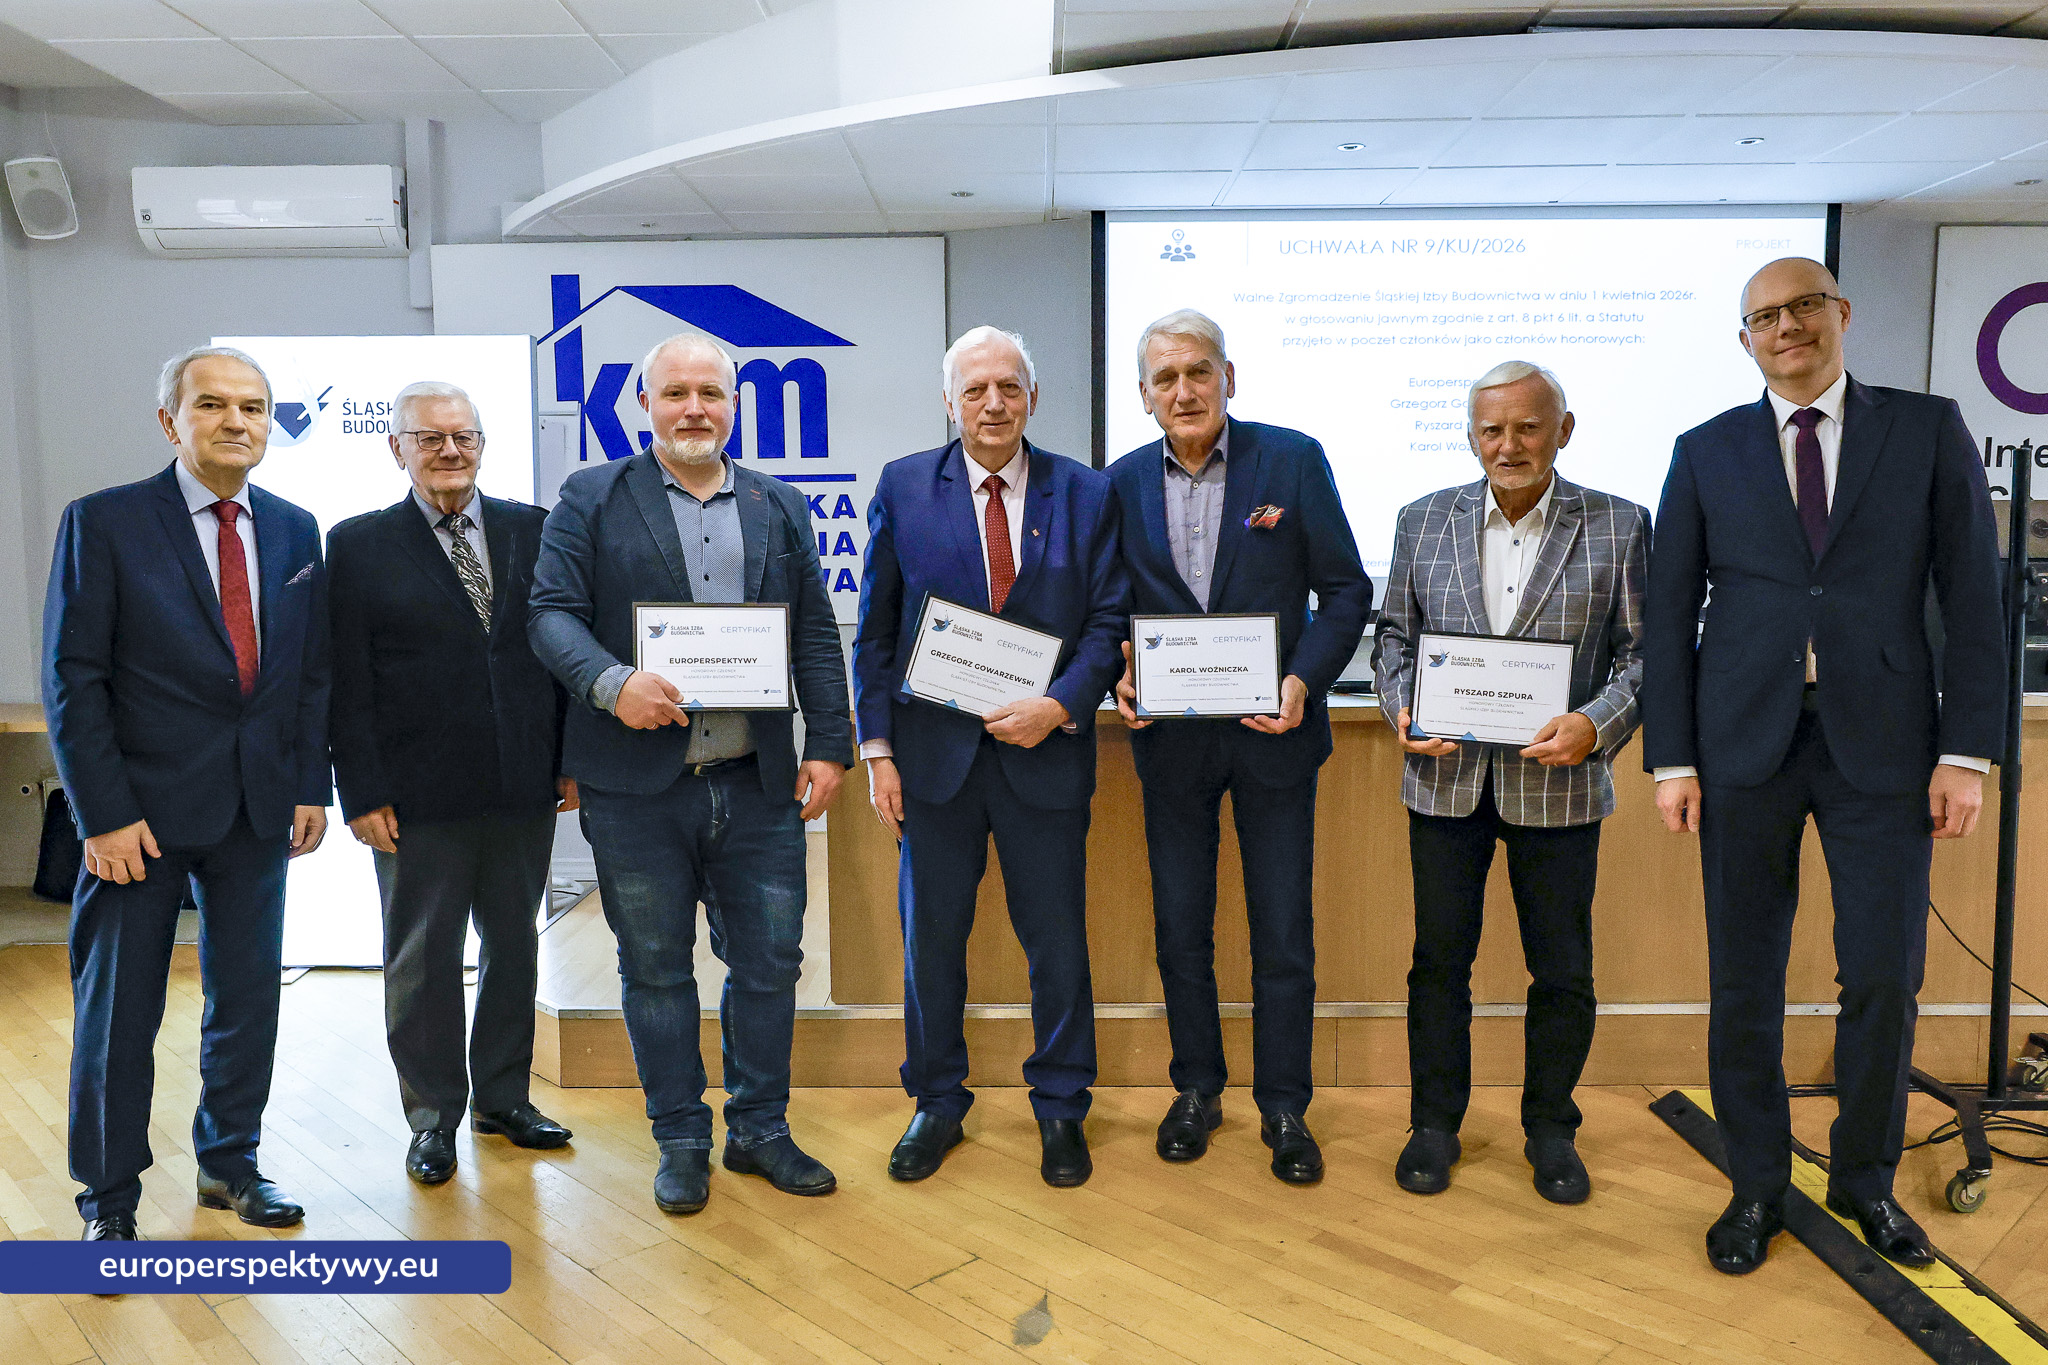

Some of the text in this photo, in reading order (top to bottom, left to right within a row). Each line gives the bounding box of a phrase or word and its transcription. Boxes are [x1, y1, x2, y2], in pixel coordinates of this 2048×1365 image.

[1279, 238, 1526, 255] UCHWAŁA NR 9/KU/2026
[1736, 239, 1791, 249] PROJEKT
[1233, 289, 1697, 305] Walne Zgromadzenie Śląskiej Izby Budownictwa w dniu 1 kwietnia 2026r.
[1285, 316, 1296, 324] w
[1299, 314, 1375, 326] głosowaniu
[1377, 313, 1429, 326] jawnym
[1432, 313, 1484, 326] zgodnie
[1487, 315, 1494, 323] z
[1498, 313, 1518, 323] art.
[1522, 313, 1530, 323] 8
[1533, 313, 1554, 325] pkt
[1557, 313, 1565, 323] 6
[1586, 314, 1595, 323] a
[1598, 312, 1644, 323] Statutu
[1336, 337, 1347, 345] w
[1351, 335, 1396, 347] poczet
[1400, 334, 1462, 345] członków
[1464, 335, 1492, 347] jako
[1496, 333, 1558, 345] członków
[1561, 333, 1646, 347] honorowych:
[1390, 398, 1447, 411] Grzegorz
[343, 420, 391, 434] BUDO
[1415, 420, 1463, 432] Ryszard
[1410, 441, 1442, 452] Karol
[720, 626, 772, 634] CERTYFIKAT
[1212, 635, 1262, 644] CERTYFIKAT
[997, 639, 1044, 659] CERTYFIKAT
[669, 657, 758, 665] EUROPERSPEKTYWY
[1501, 660, 1556, 670] CERTYFIKAT
[930, 649, 1035, 687] GRZEGORZ GOWARZEWSKI
[1454, 688, 1534, 701] RYSZARD SZPURA
